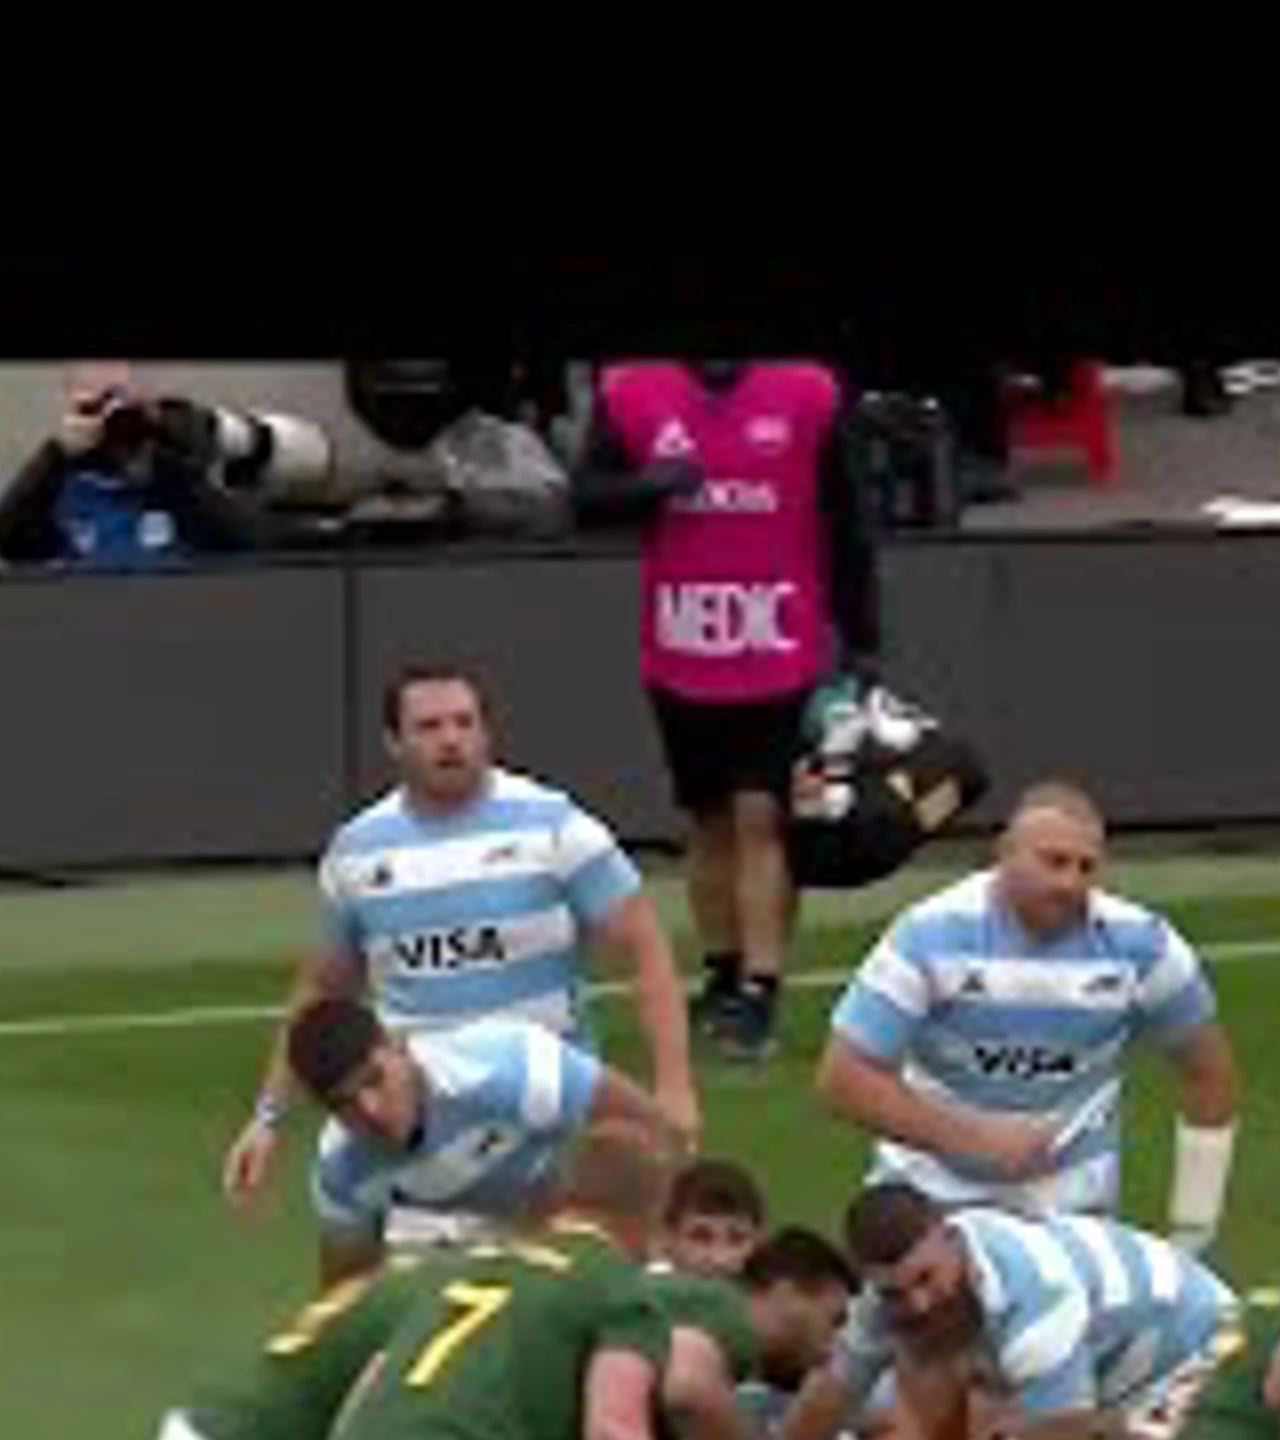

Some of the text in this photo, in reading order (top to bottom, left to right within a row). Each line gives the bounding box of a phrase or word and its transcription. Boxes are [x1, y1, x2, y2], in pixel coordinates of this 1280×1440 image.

[654, 581, 800, 656] MEDIC
[392, 926, 506, 969] VISA
[974, 1045, 1076, 1081] VISA
[405, 1282, 514, 1387] 7
